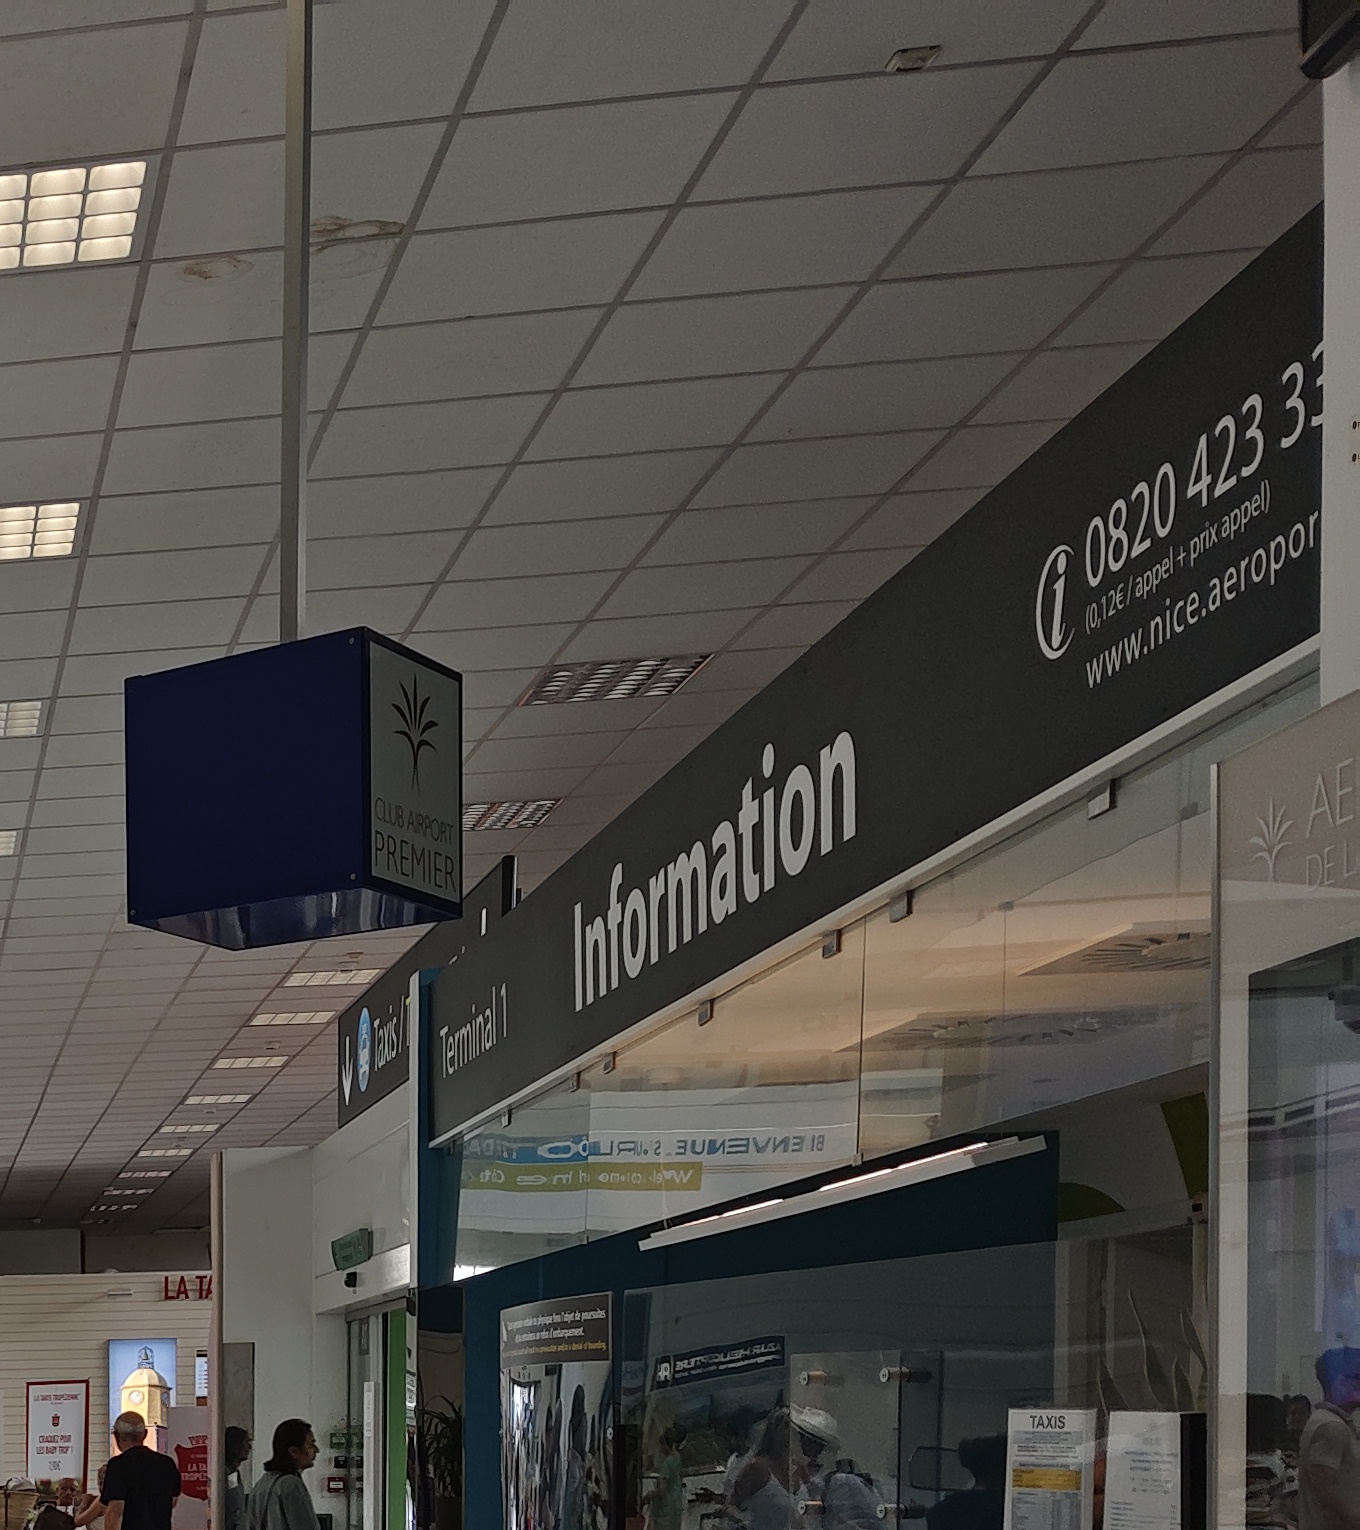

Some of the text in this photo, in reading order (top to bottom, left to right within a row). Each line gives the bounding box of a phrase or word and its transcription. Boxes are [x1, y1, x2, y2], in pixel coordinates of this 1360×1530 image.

[1084, 461, 1176, 587] 0820
[1186, 393, 1265, 508] 423
[1085, 587, 1125, 635] (0,12€
[1134, 545, 1175, 600] appel
[1188, 520, 1219, 567] prix
[1220, 478, 1272, 541] appel)
[374, 797, 455, 846] CLUB AIRPORT
[374, 829, 458, 893] PREMIER
[573, 731, 857, 1013] Information
[373, 1004, 398, 1072] Taxis
[439, 982, 508, 1079] Terminal 1
[164, 1275, 190, 1300] LA
[1029, 1414, 1067, 1430] TAXIS
